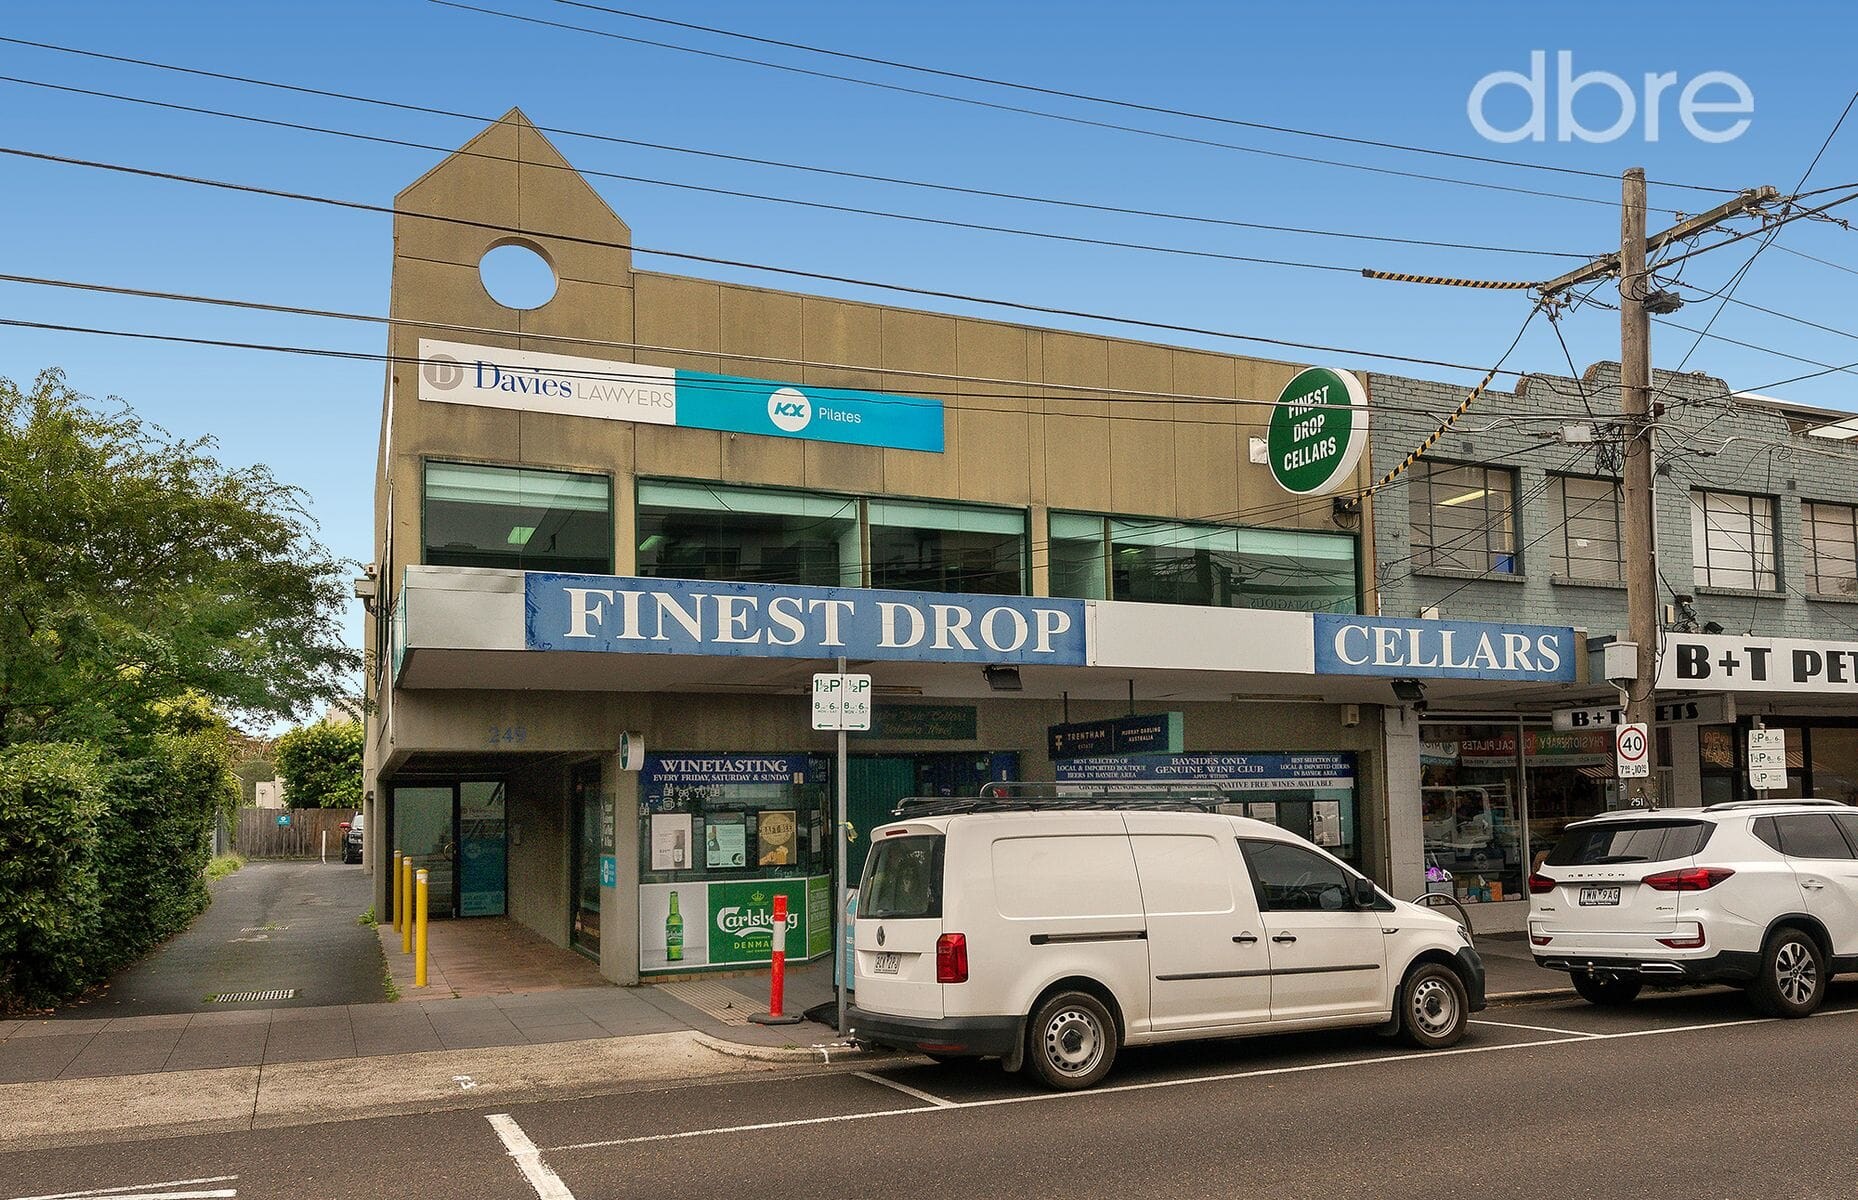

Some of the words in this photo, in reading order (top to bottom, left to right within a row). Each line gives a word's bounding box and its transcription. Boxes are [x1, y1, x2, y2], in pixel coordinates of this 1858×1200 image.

[473, 360, 572, 398] Davies
[577, 382, 674, 409] LAWYERS
[774, 402, 805, 418] KX
[1287, 385, 1329, 419] FINEST
[819, 407, 862, 424] Pilates
[1294, 414, 1325, 443] DROP
[1284, 436, 1337, 471] CELLARS
[563, 587, 855, 647] FINEST
[875, 601, 1072, 654] DROP
[1334, 624, 1560, 673] CELLARS
[1655, 702, 1699, 721] ETS
[1067, 730, 1105, 741] TRENTHAM
[1623, 736, 1642, 751] 40
[660, 759, 788, 773] WINETASTING
[1155, 765, 1203, 774] GENUINE
[1206, 765, 1235, 773] WINE
[1238, 765, 1264, 773] CLUB
[1171, 757, 1219, 766] BAYSIDES
[1221, 757, 1248, 765] ONLY
[653, 774, 680, 782] EVERY
[711, 773, 750, 781] SATURDAY
[761, 773, 791, 781] SUNDAY
[1631, 798, 1644, 806] 251
[717, 906, 798, 933] Carlsbg
[734, 940, 773, 949] DENMA
